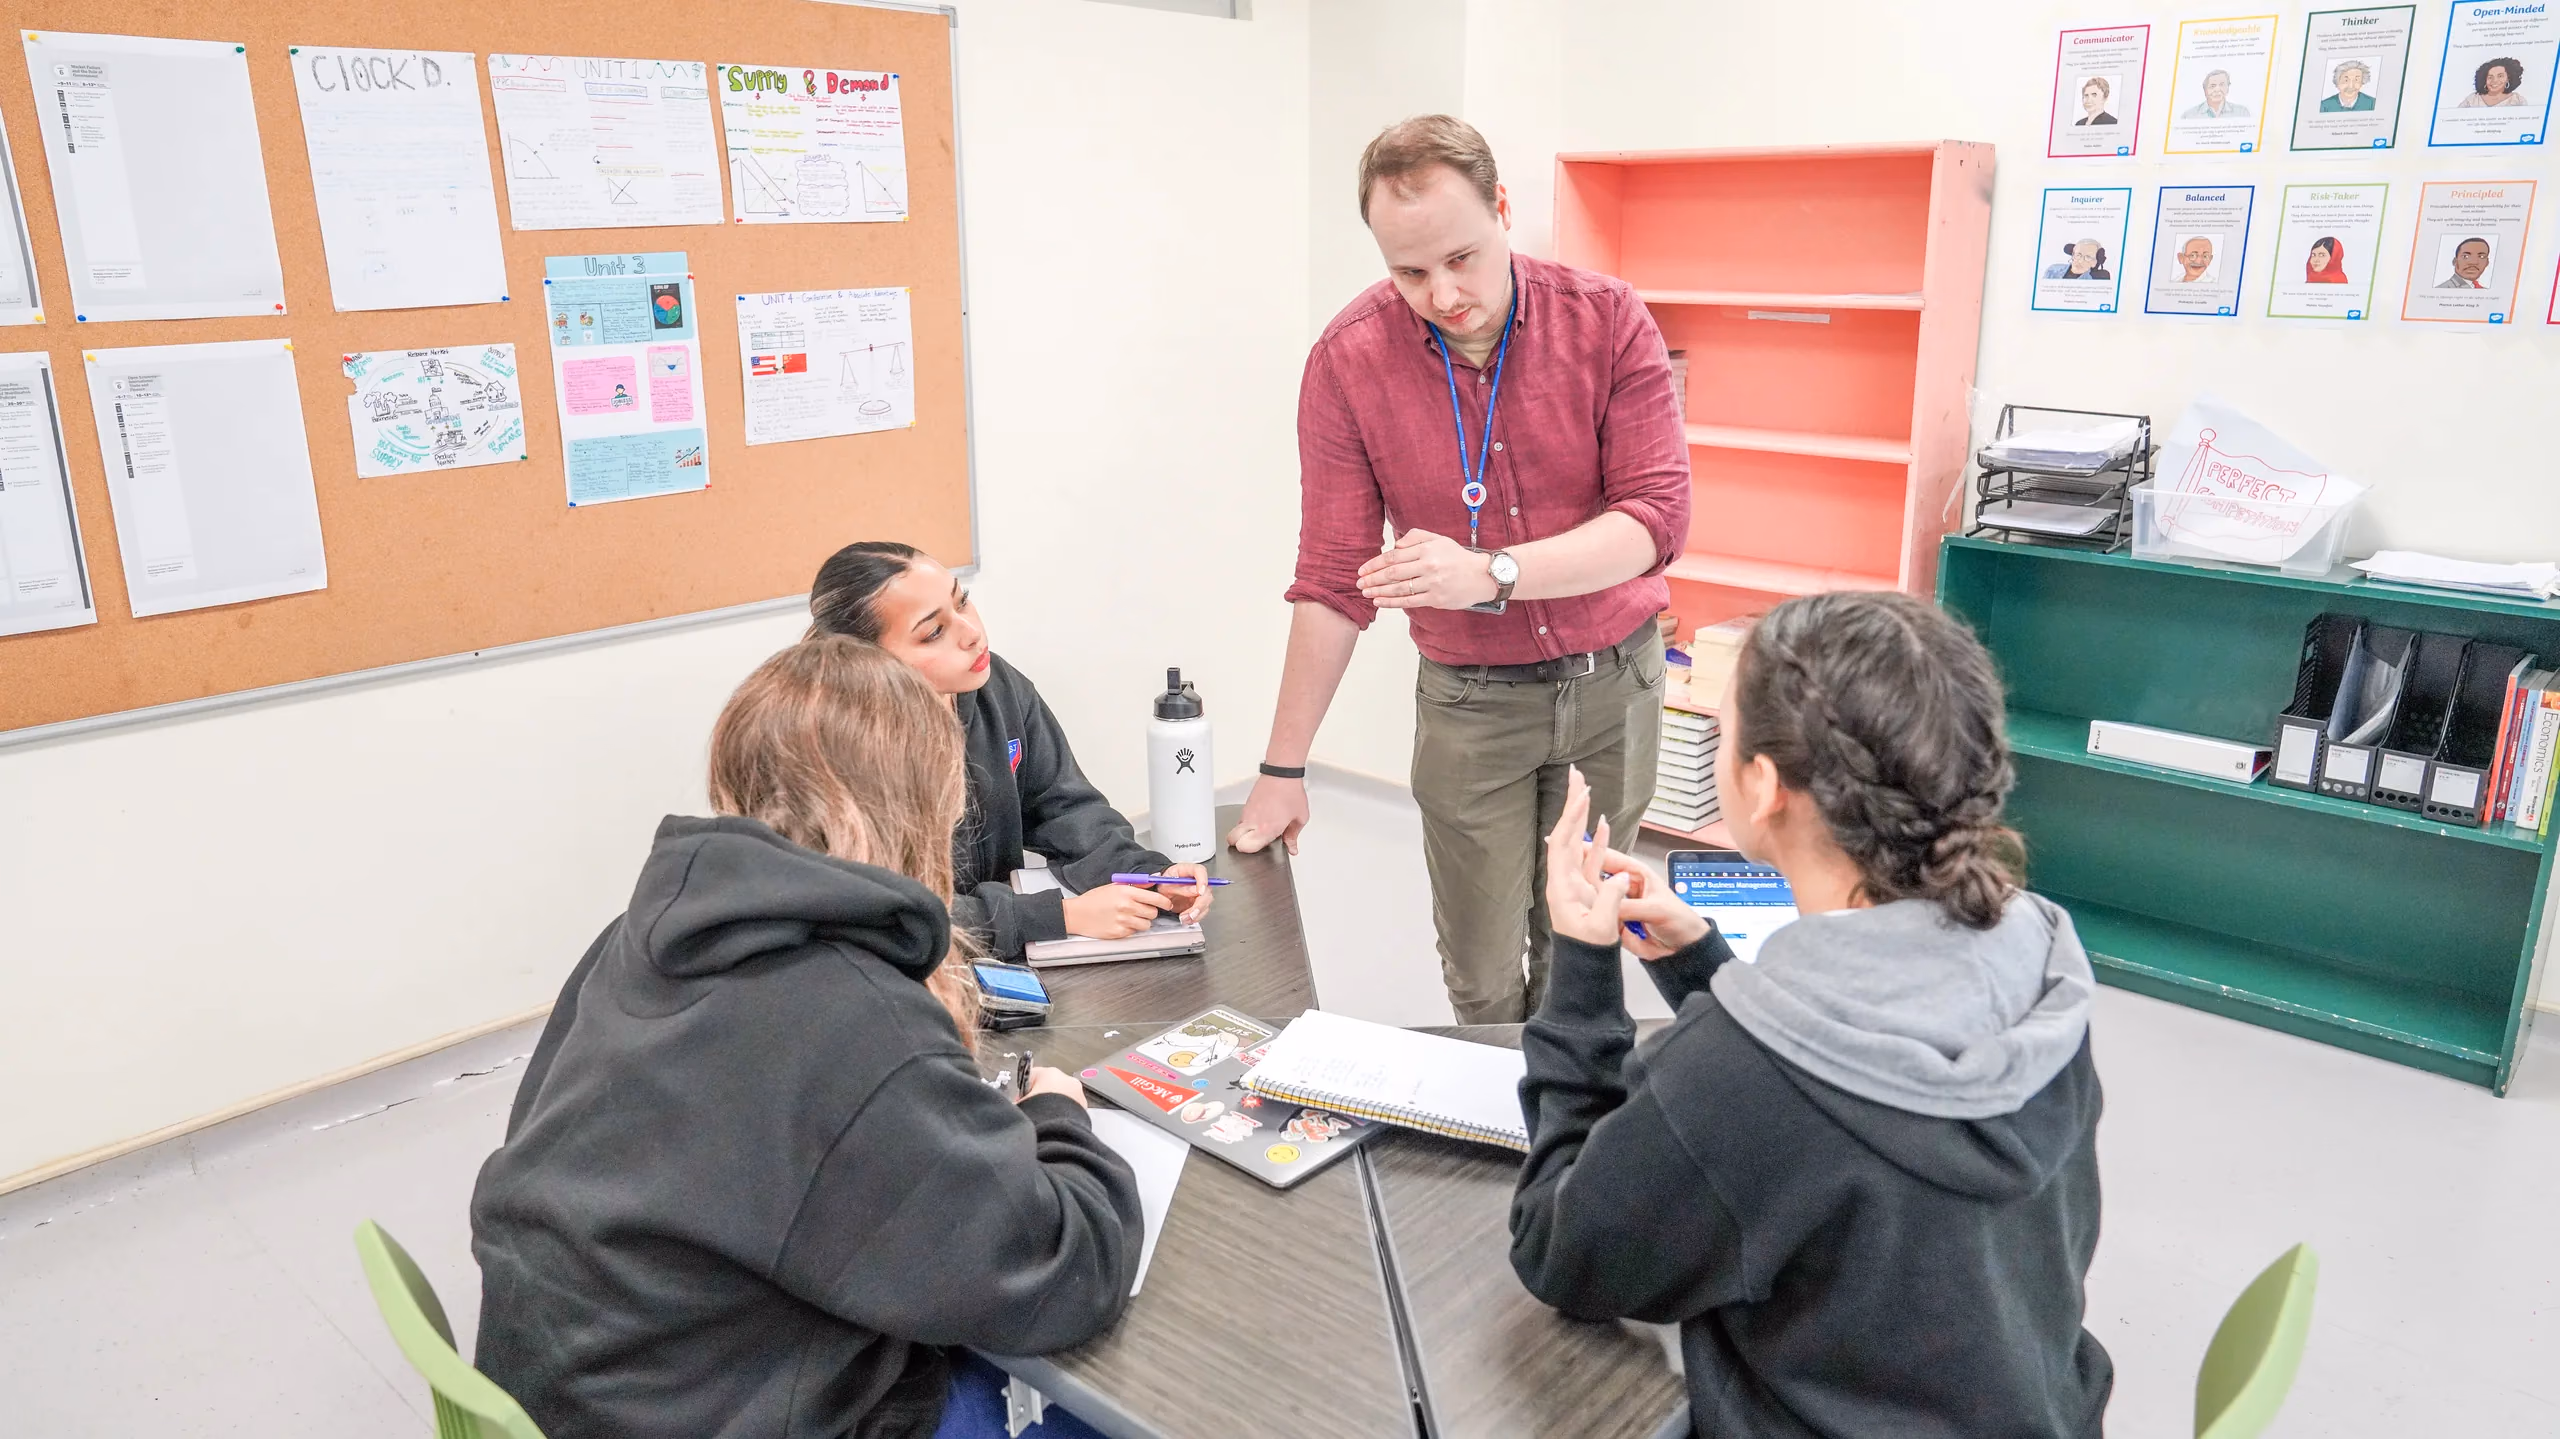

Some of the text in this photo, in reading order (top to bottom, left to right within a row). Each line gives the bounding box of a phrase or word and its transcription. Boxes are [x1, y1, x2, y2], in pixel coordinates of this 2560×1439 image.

[2473, 4, 2546, 18] Open-Minded
[2342, 16, 2380, 26] Thinker
[2074, 35, 2134, 44] Communicator
[574, 59, 625, 78] UNIT
[728, 66, 788, 94] Supply
[826, 72, 889, 94] Demand
[2071, 196, 2104, 204] Inquirer
[2310, 192, 2360, 200] Risk-Taker
[2450, 189, 2504, 200] Principled
[584, 255, 646, 276] Unit 3
[762, 294, 785, 305] UNIT
[788, 293, 794, 304] 4
[2206, 462, 2296, 502] PERFECT
[2196, 487, 2300, 534] COMPETITION
[2534, 712, 2558, 772] Economics
[1736, 882, 1778, 890] Management
[1130, 1076, 1174, 1098] McGill
